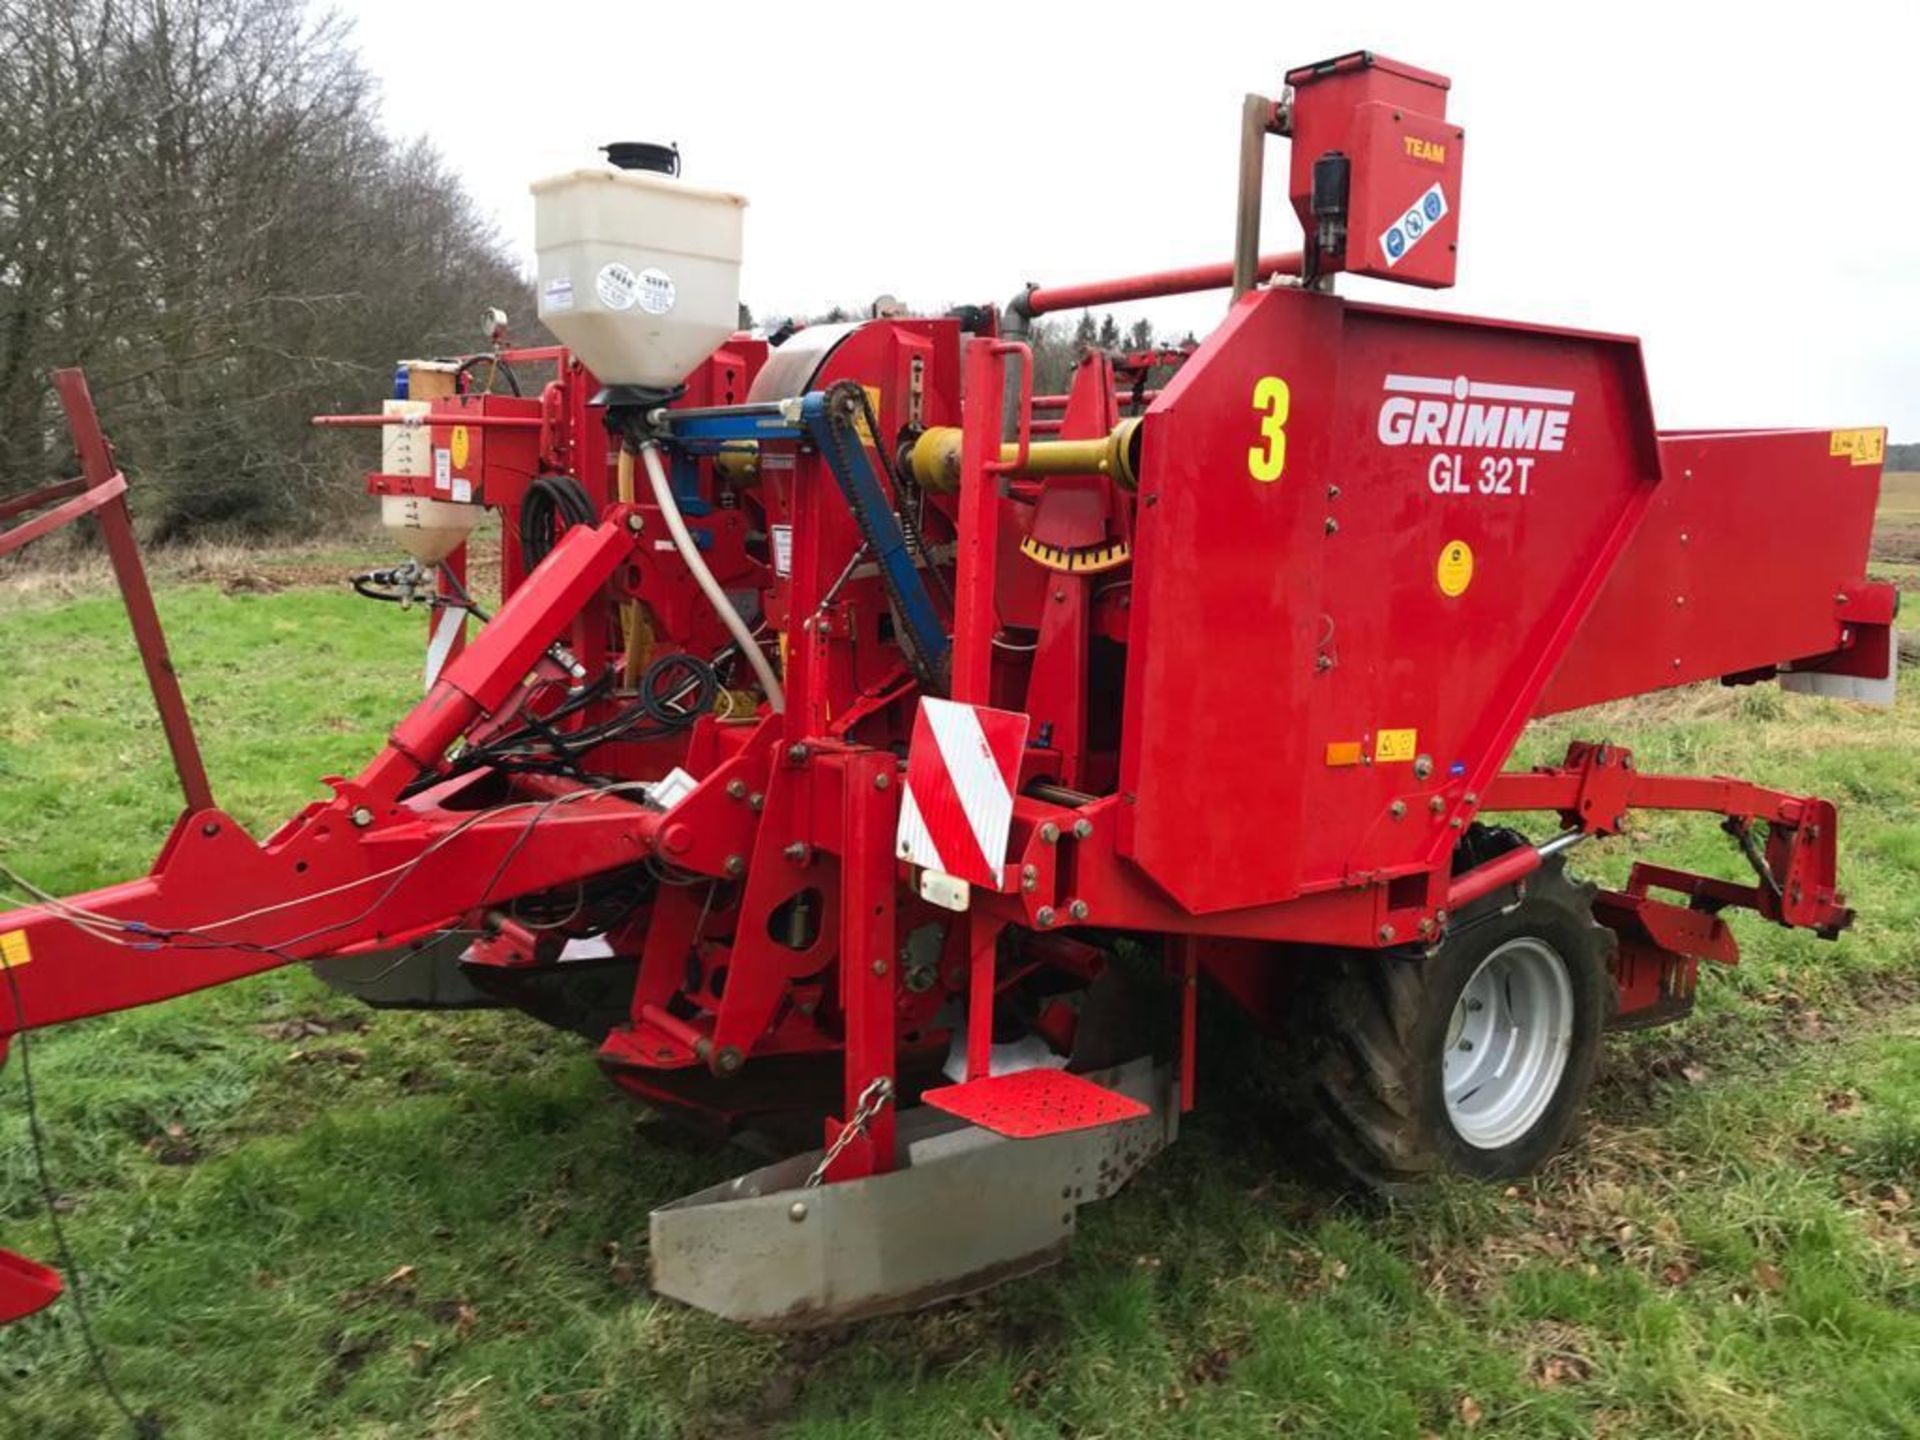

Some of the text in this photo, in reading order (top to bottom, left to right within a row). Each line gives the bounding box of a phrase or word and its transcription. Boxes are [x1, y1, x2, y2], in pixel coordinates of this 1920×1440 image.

[1404, 136, 1445, 164] TEAM
[1248, 376, 1291, 482] 3
[1378, 376, 1570, 450] GRIMME
[1427, 453, 1536, 496] GL 32T
